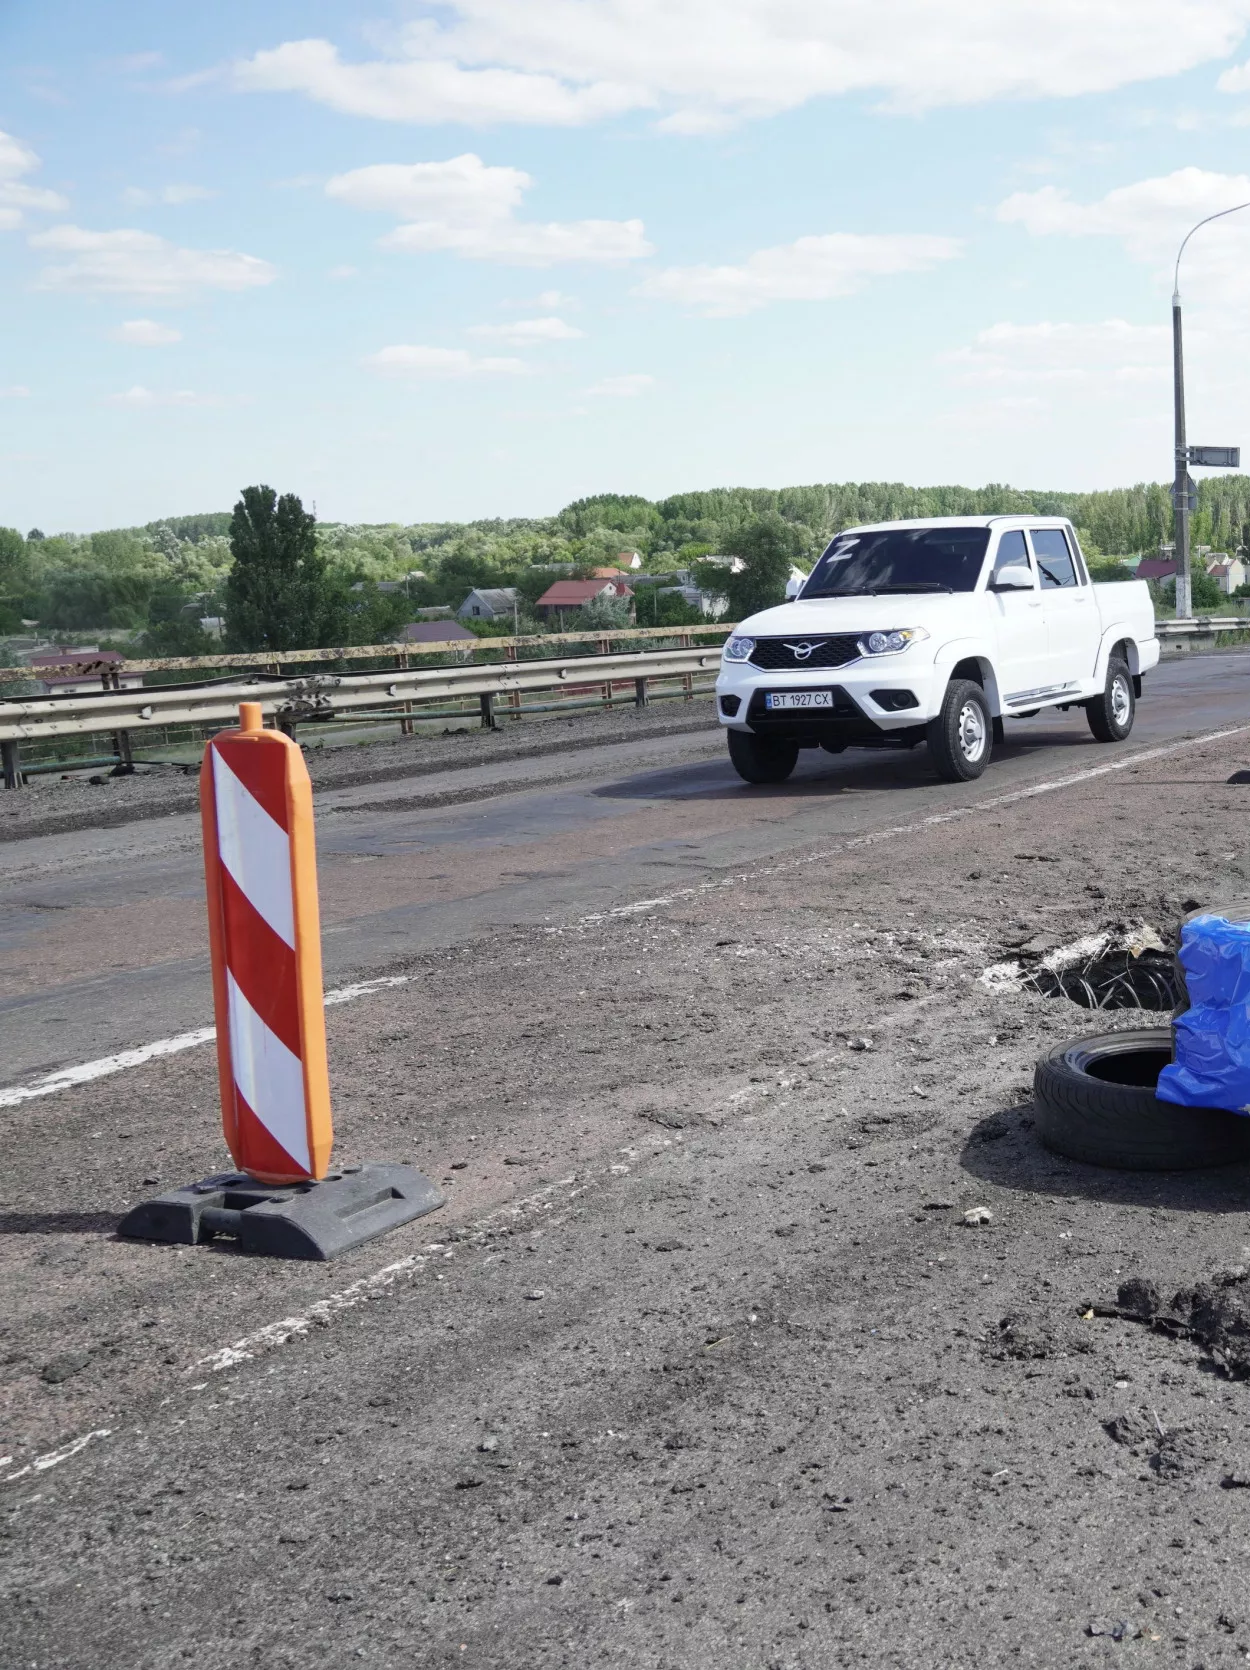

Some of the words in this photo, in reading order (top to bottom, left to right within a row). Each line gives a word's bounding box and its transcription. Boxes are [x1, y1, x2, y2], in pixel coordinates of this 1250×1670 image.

[826, 539, 861, 564] Z
[772, 695, 787, 707] BT
[790, 694, 812, 706] 1927
[814, 693, 829, 705] CX
